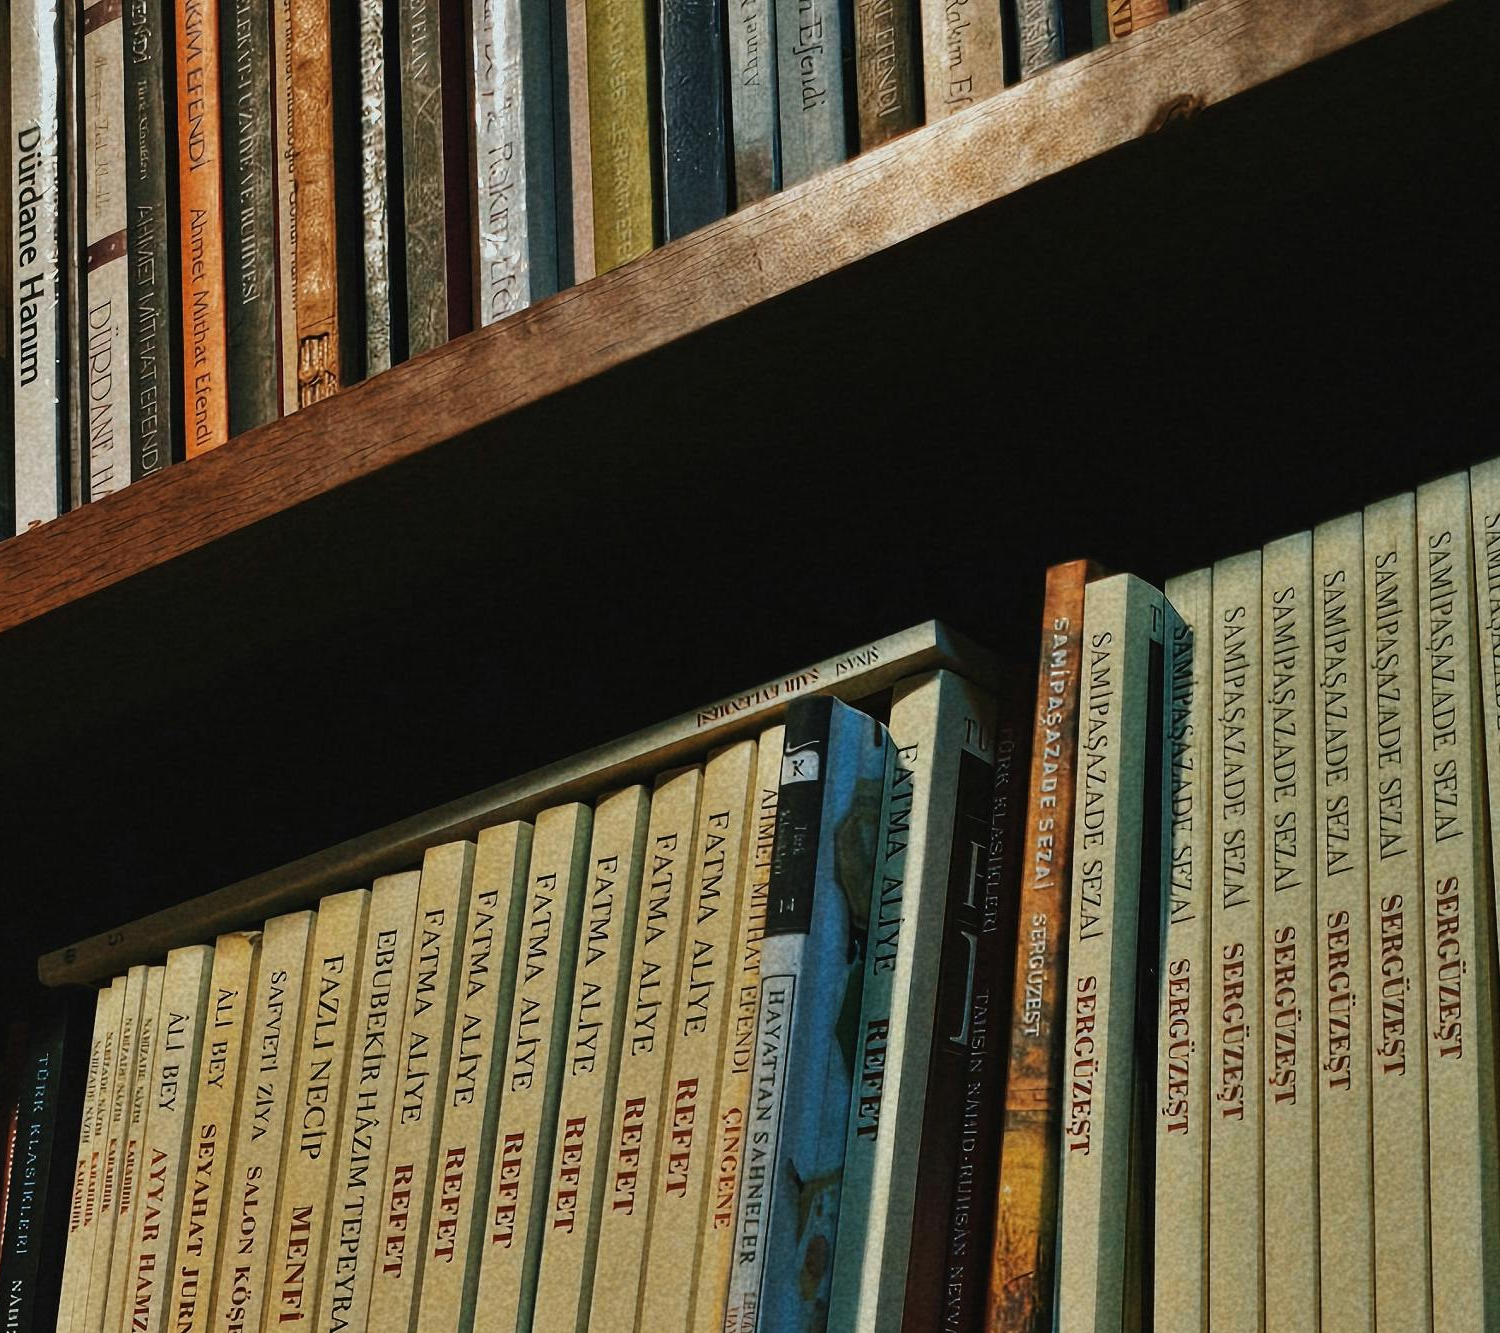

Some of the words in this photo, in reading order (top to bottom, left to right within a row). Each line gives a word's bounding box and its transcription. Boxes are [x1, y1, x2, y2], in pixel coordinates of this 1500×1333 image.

[794, 21, 825, 112] Efendi
[18, 126, 43, 267] Dürdane
[190, 208, 207, 282] Ahmet
[18, 276, 43, 388] Hanım
[1218, 606, 1250, 820] SAMİPAŞAZADE
[1372, 551, 1405, 764] SAMİPAŞAZADE
[696, 812, 730, 924] FATMA
[1223, 832, 1250, 909] SEZAİ
[1379, 778, 1408, 861] SEZAİ
[307, 955, 345, 1052] FAZLI
[357, 930, 395, 1086] EBUBEKİR
[684, 939, 715, 1036] ALİYE
[1218, 943, 1249, 1122] SERGÜZEŞT
[1378, 894, 1410, 1076] SERGÜZEŞT
[207, 1040, 227, 1089] BEY
[300, 1059, 333, 1160] NECİP
[756, 990, 786, 1121] HAYATTAN
[187, 1124, 217, 1256] SEYAHAT
[666, 1077, 700, 1198] REFET
[142, 1149, 168, 1241] AYYAR
[238, 1165, 263, 1254] SALON
[739, 1132, 770, 1265] SAHNELER
[278, 1205, 313, 1324] MENFİ
